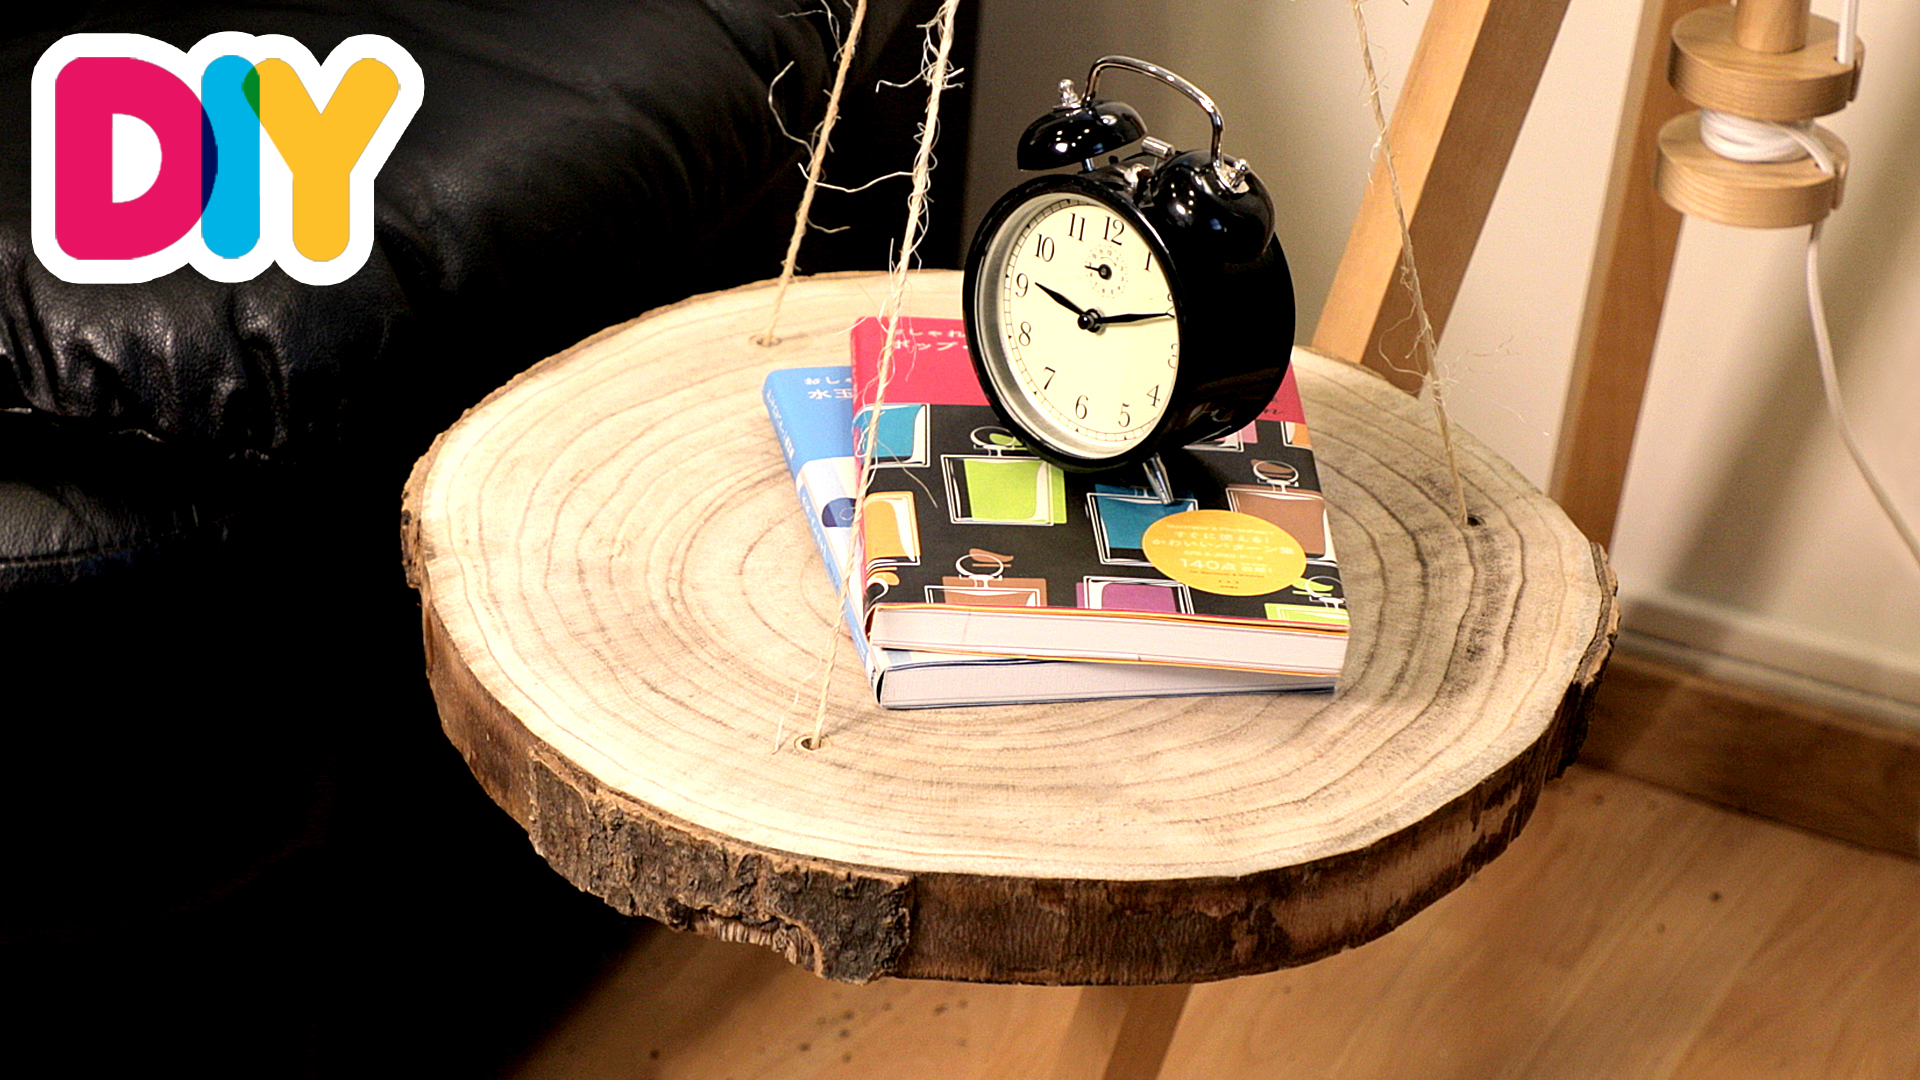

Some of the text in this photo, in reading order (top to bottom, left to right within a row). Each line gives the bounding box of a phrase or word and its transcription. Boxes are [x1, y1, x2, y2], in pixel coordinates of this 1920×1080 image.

[1068, 212, 1086, 242] 11
[1101, 215, 1126, 246] 12
[1035, 233, 1055, 263] 10
[1143, 251, 1152, 272] 1
[1014, 273, 1029, 298] 9
[1018, 321, 1032, 346] 8
[1043, 366, 1056, 390] 7
[807, 388, 855, 400] 水玉
[1146, 384, 1161, 408] 4
[1075, 394, 1089, 420] 6
[1117, 402, 1131, 428] 5
